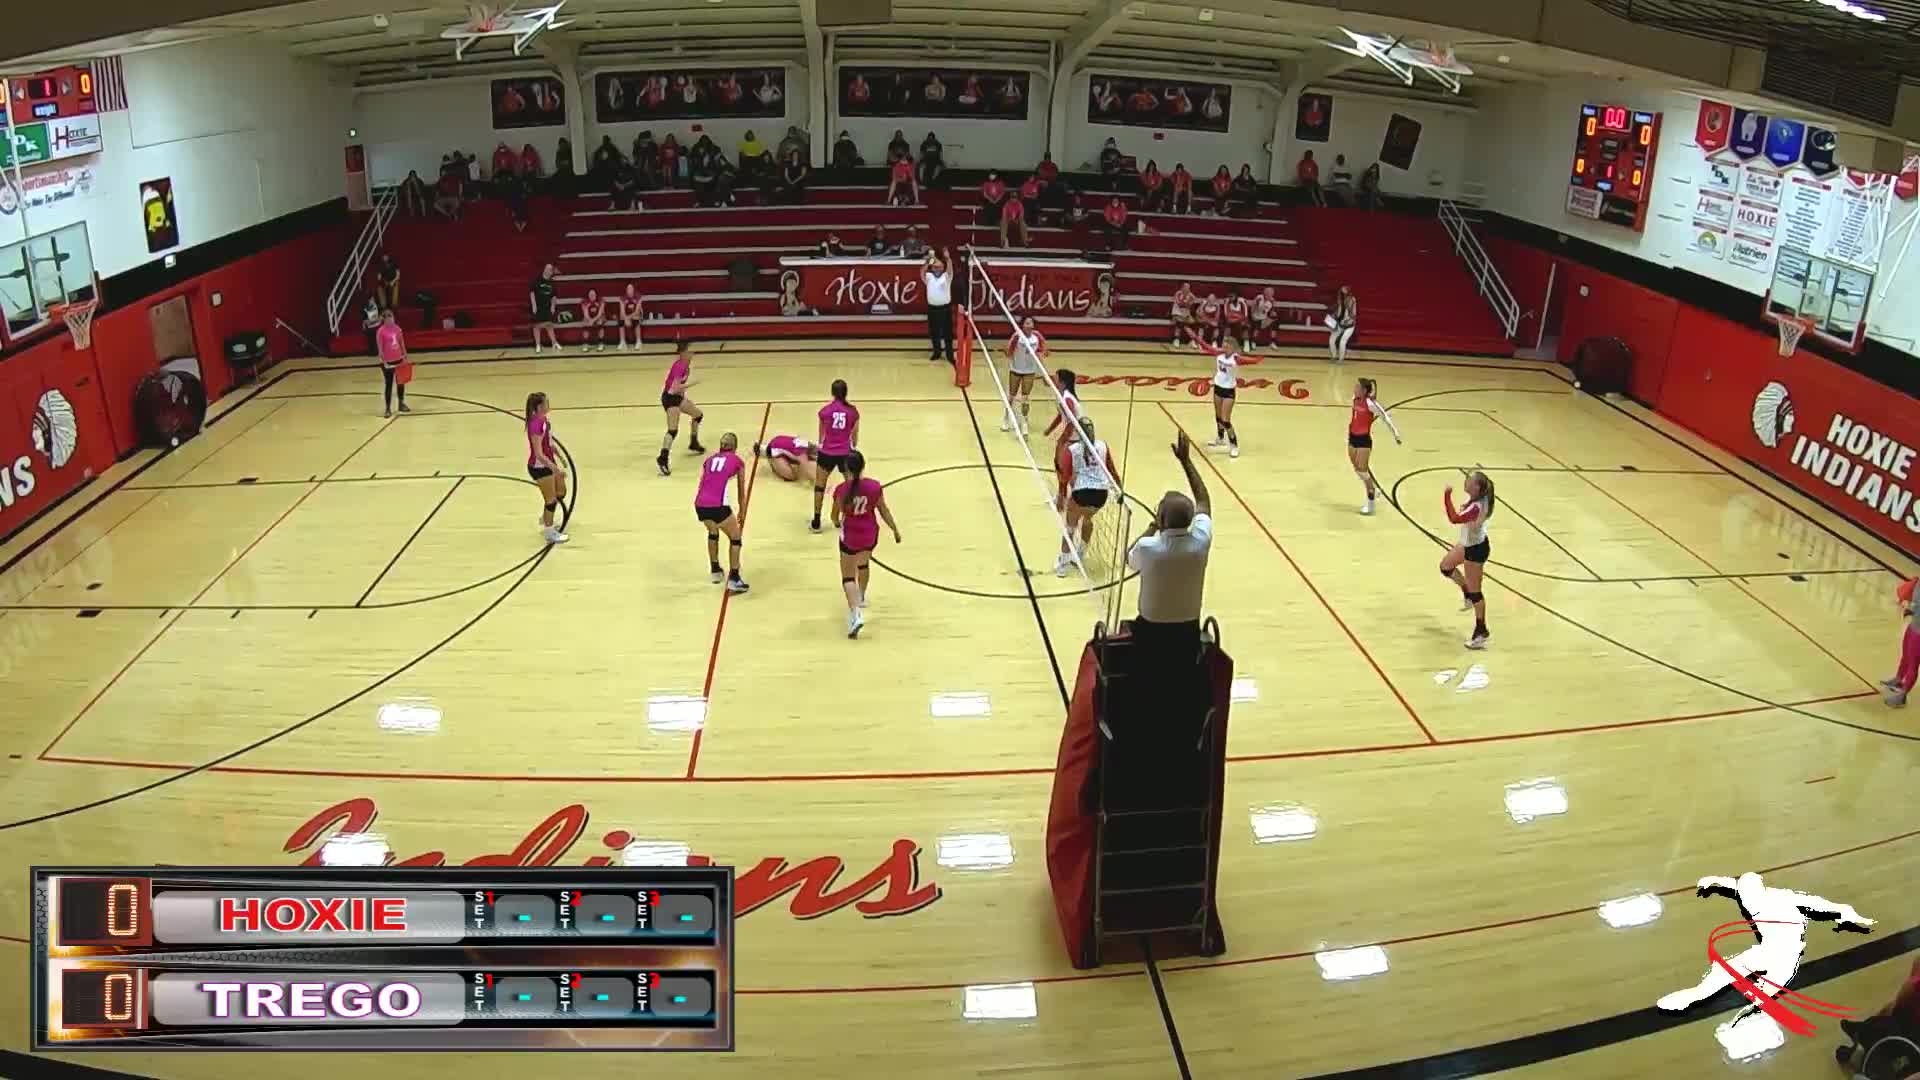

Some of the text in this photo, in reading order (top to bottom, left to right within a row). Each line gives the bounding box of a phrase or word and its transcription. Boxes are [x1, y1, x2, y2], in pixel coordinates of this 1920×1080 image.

[80, 73, 91, 94] 0
[1586, 117, 1597, 136] 0
[1640, 125, 1652, 145] 0
[1576, 158, 1585, 173] 0
[1632, 169, 1642, 186] 0
[1737, 208, 1777, 227] HOXIE
[825, 269, 918, 305] Hoxie
[832, 411, 847, 430] 25
[1826, 412, 1918, 481] HOXIE
[1790, 434, 1920, 534] INDIANS
